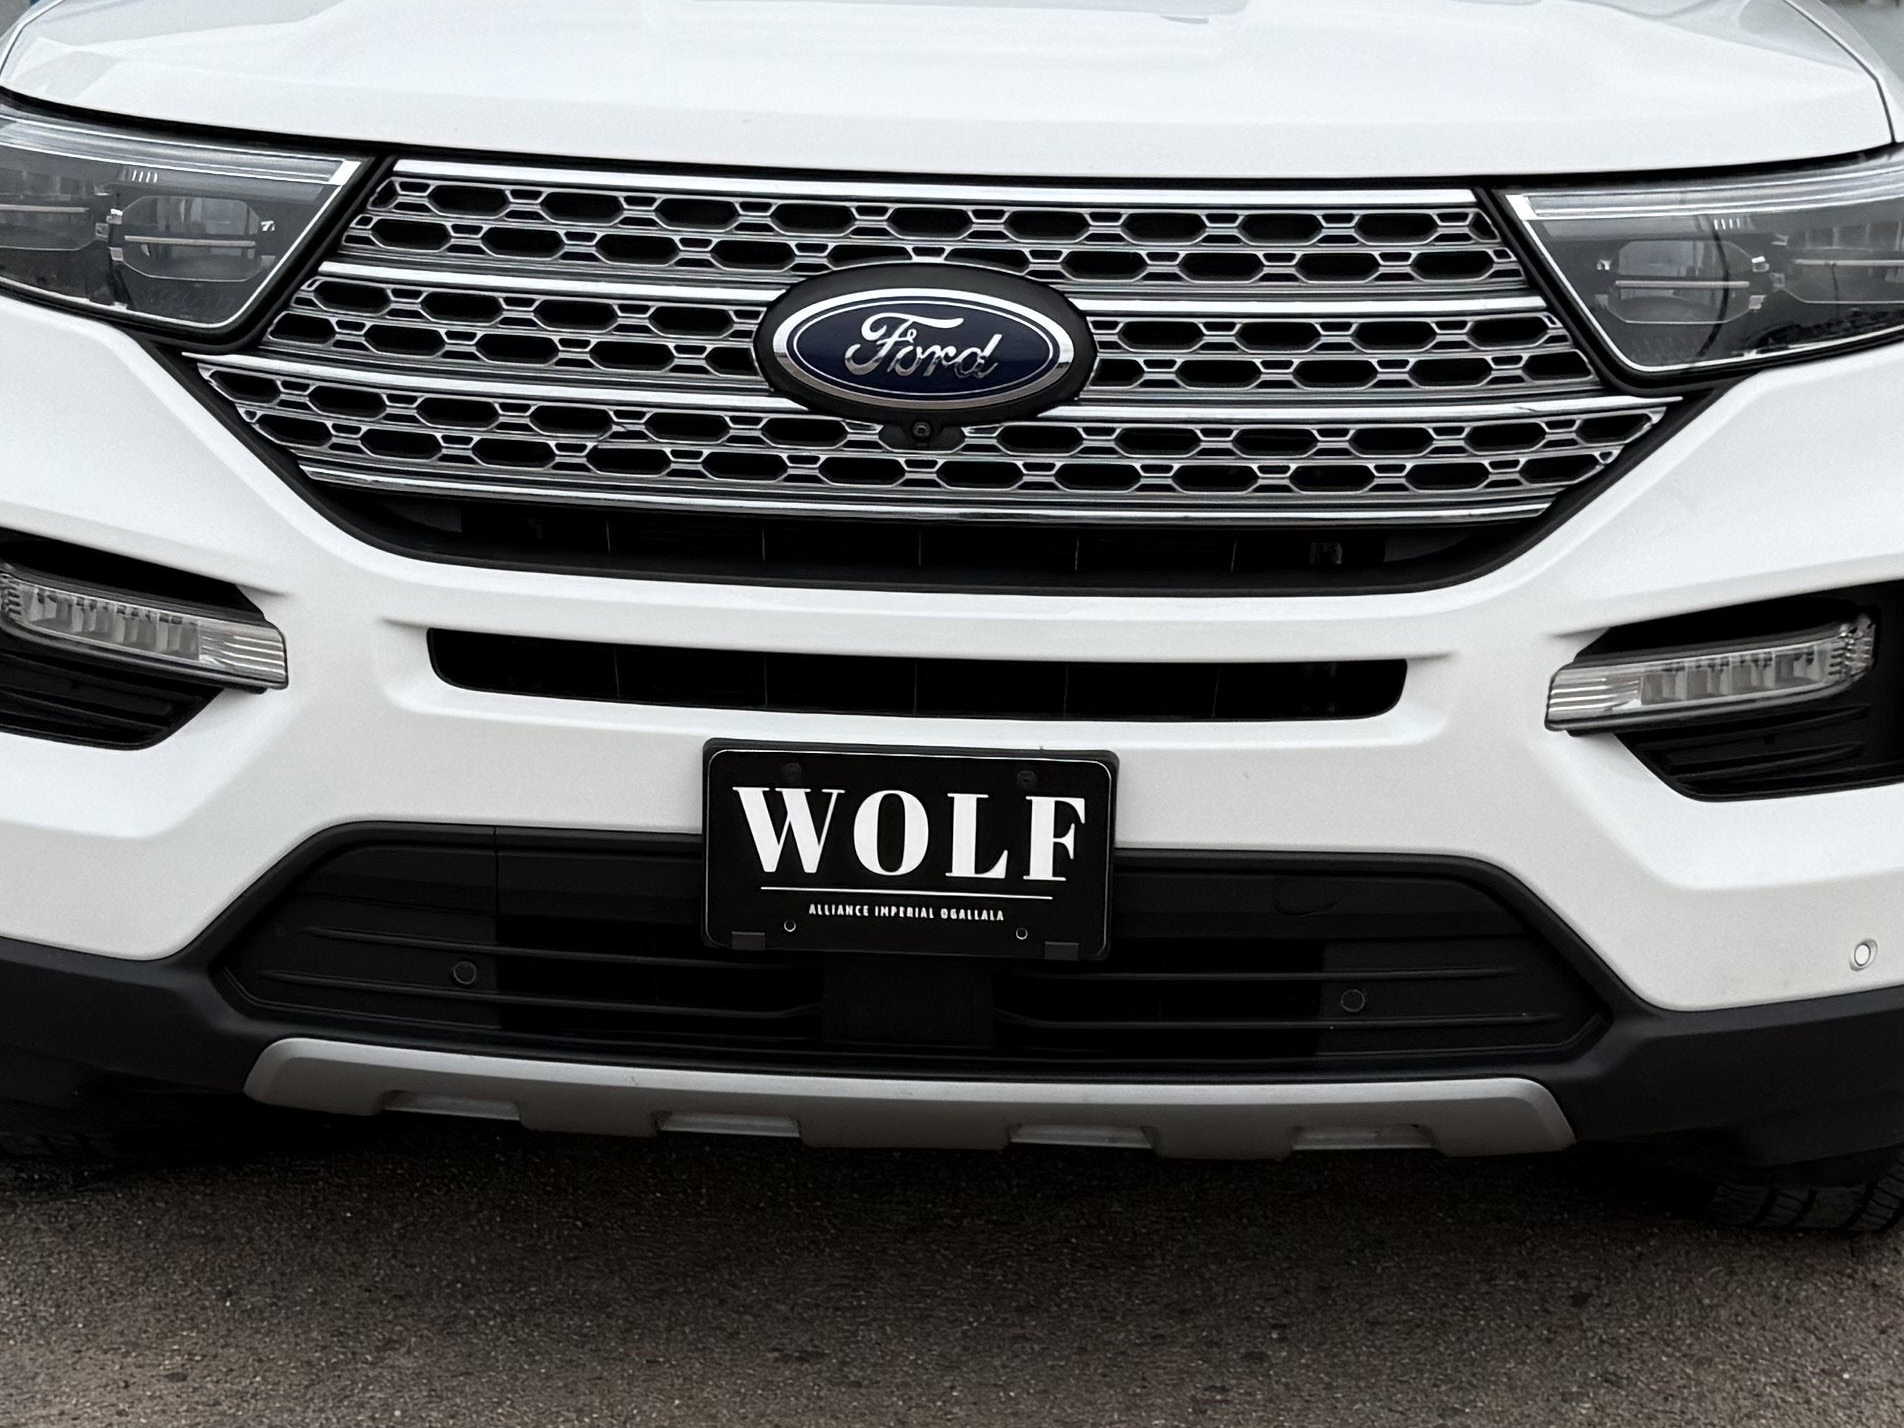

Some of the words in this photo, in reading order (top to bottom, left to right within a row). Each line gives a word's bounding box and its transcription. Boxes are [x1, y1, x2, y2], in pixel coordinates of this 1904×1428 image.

[844, 311, 1003, 379] Ford
[732, 786, 1086, 882] WOLF
[809, 903, 870, 917] ALLIANCE
[874, 905, 935, 919] IMPERIAL
[940, 907, 1005, 921] OGALLALA
